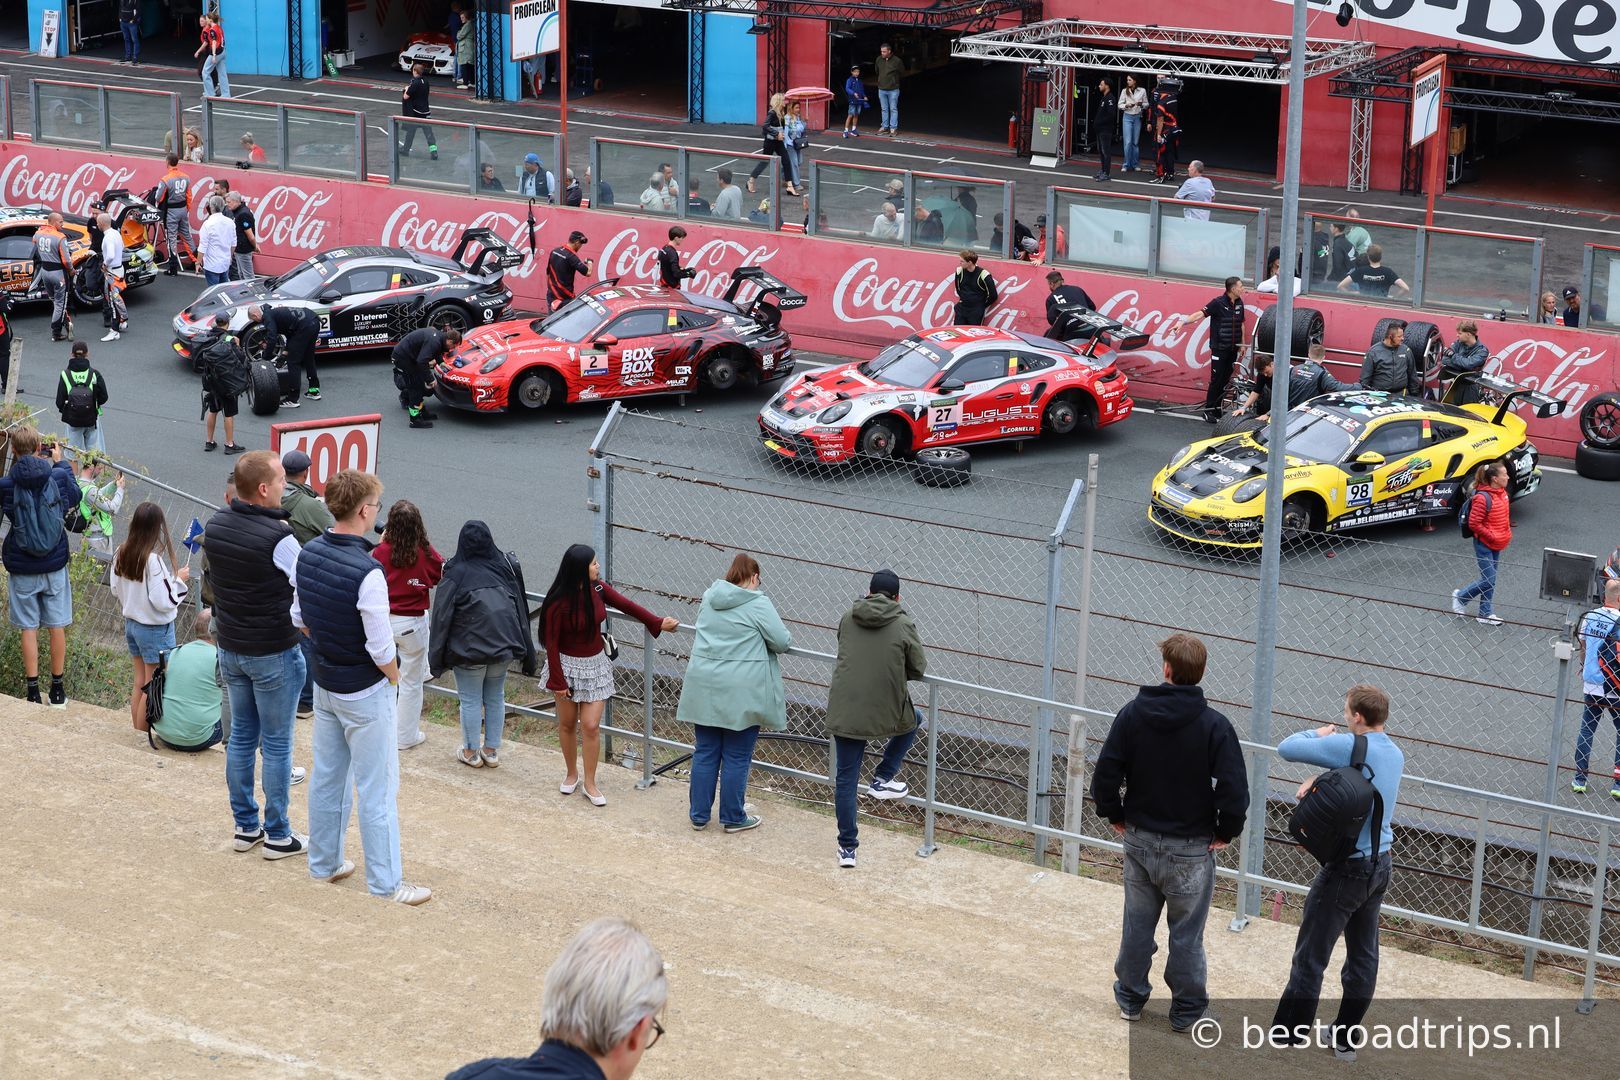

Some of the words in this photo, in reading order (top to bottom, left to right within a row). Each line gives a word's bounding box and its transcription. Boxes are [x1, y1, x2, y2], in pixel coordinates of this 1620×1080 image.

[514, 0, 556, 20] PROFICLEAN
[1037, 113, 1057, 124] STOP
[0, 154, 136, 220] Coca-Cola
[174, 179, 187, 194] 99
[188, 176, 333, 250] Co-Cola
[38, 236, 52, 252] 99
[597, 228, 779, 304] Coc-Cola
[832, 257, 1032, 332] Coca-Cla
[328, 332, 389, 344] SKYLIMITEVENTS.COM
[589, 355, 598, 369] 2
[622, 346, 655, 363] BOX
[620, 359, 656, 375] BOX
[935, 408, 952, 422] 27
[962, 405, 1039, 419] AUGUST
[1351, 484, 1369, 500] 98
[1433, 487, 1453, 495] Quick
[1339, 508, 1417, 528] WWW.BELGIUMRACING.BE
[1590, 628, 1609, 639] MEDI
